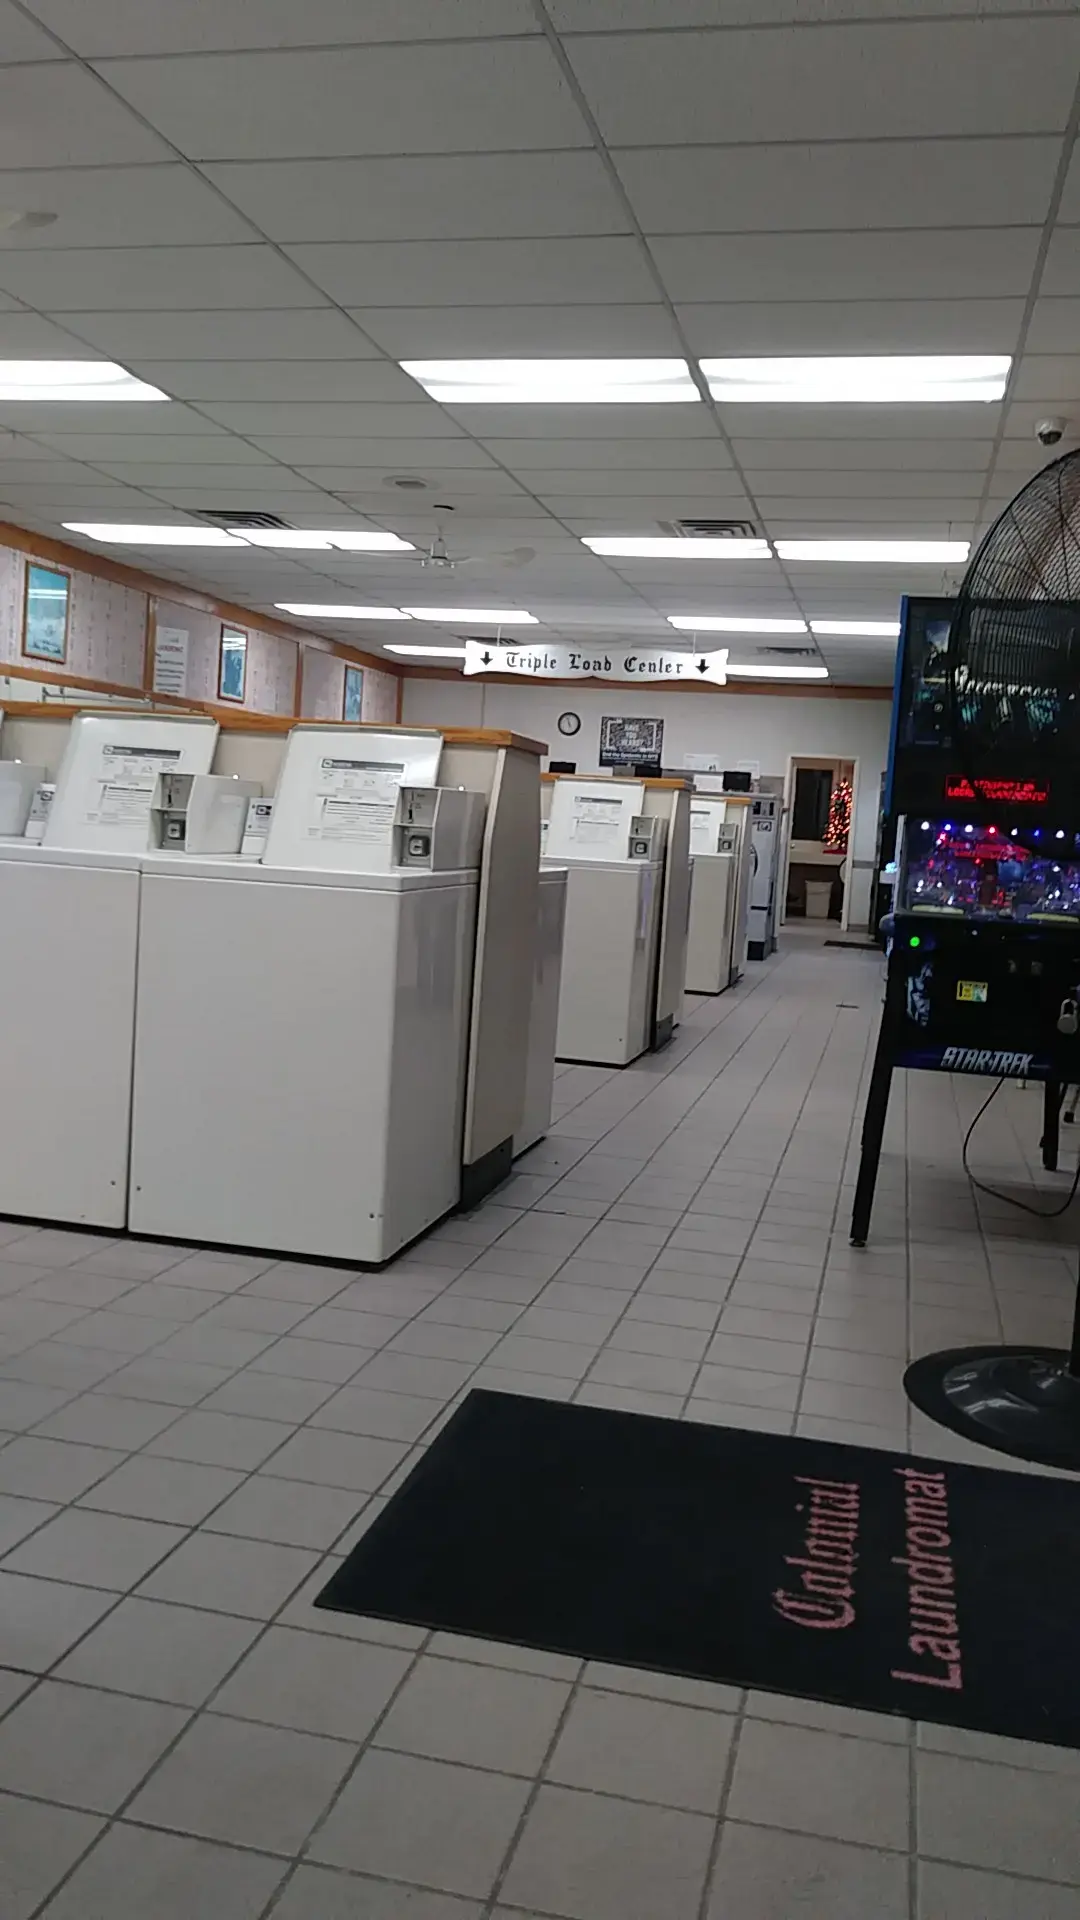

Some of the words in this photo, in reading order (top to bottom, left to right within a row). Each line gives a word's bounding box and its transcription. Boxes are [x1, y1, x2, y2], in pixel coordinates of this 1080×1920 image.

[506, 651, 557, 672] Triple
[568, 653, 612, 672] Load
[623, 655, 683, 673] Center
[772, 1476, 860, 1630] Colonial
[891, 1467, 963, 1690] Laundromat
